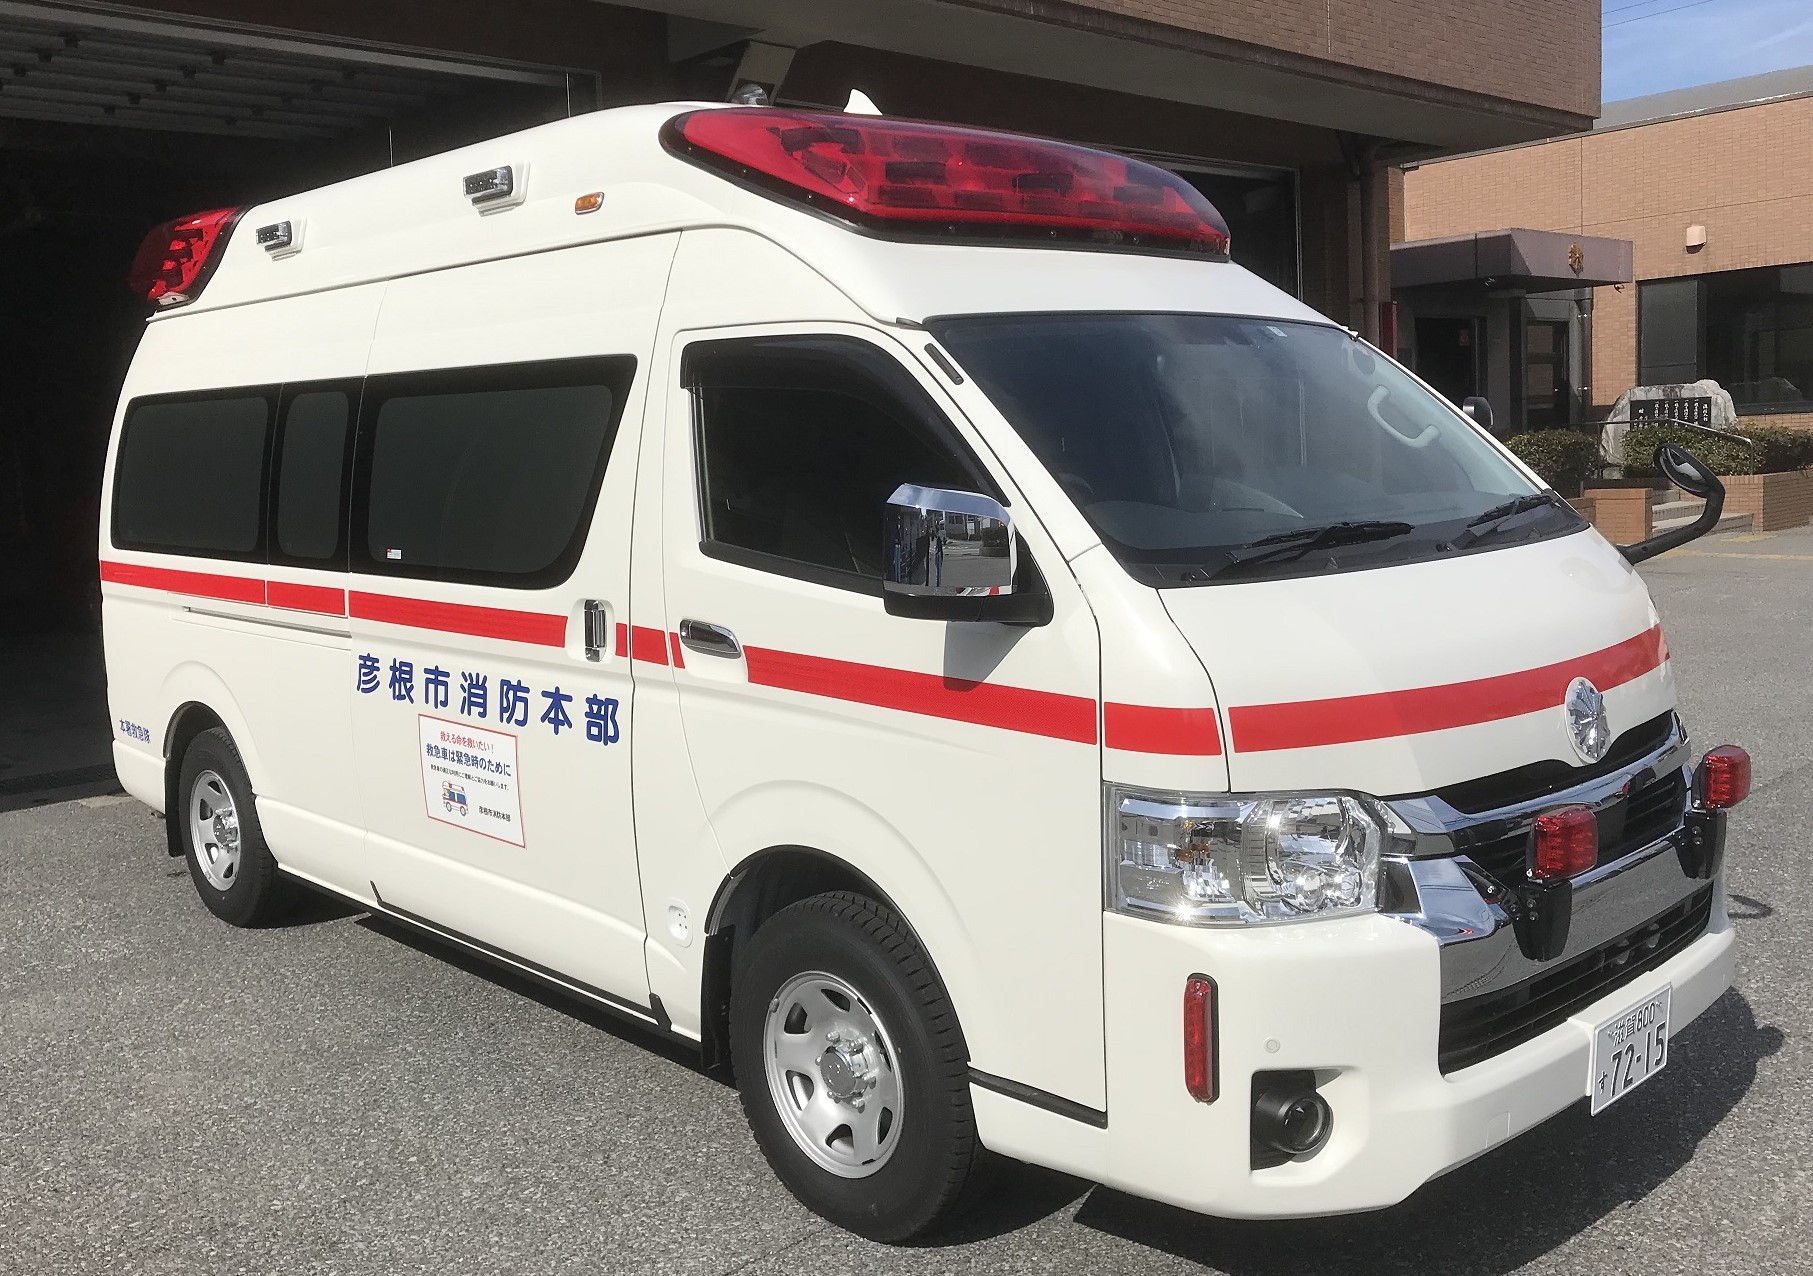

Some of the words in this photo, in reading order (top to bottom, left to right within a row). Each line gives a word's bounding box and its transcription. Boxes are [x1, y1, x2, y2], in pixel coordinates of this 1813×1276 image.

[356, 653, 620, 747] 彦根市消防本部
[426, 743, 512, 777] 救急車は緊急時のために
[1598, 1070, 1608, 1095] す
[1610, 1020, 1666, 1097] 72-15
